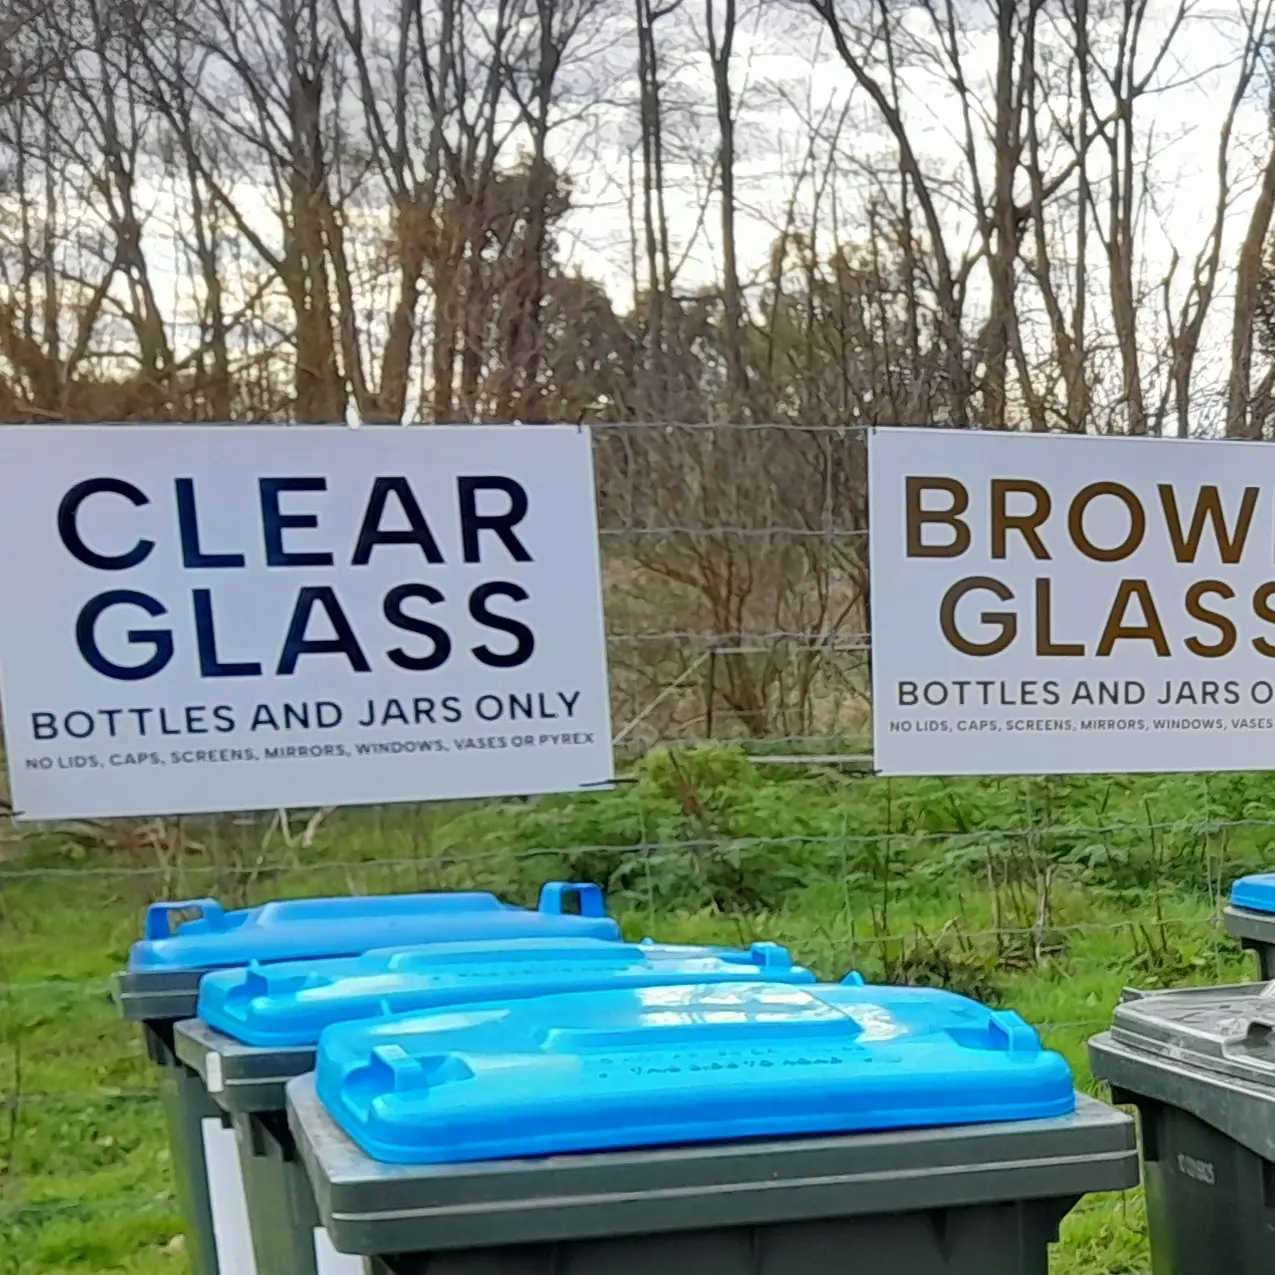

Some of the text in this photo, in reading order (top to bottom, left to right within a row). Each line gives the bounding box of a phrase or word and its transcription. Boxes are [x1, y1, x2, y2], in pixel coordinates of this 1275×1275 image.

[57, 475, 535, 571] CLEAR
[75, 580, 536, 681] GLASS
[31, 690, 581, 740] BOTTLES AND JARS ONLY
[898, 680, 1060, 706] BOTTLES
[1071, 680, 1146, 706] AND
[1157, 680, 1240, 705] JARS
[890, 720, 912, 732] NO
[1232, 717, 1273, 729] VASES
[25, 756, 52, 770] NO
[453, 735, 507, 751] VASES
[511, 734, 535, 747] OR
[538, 731, 595, 746] PYREX
